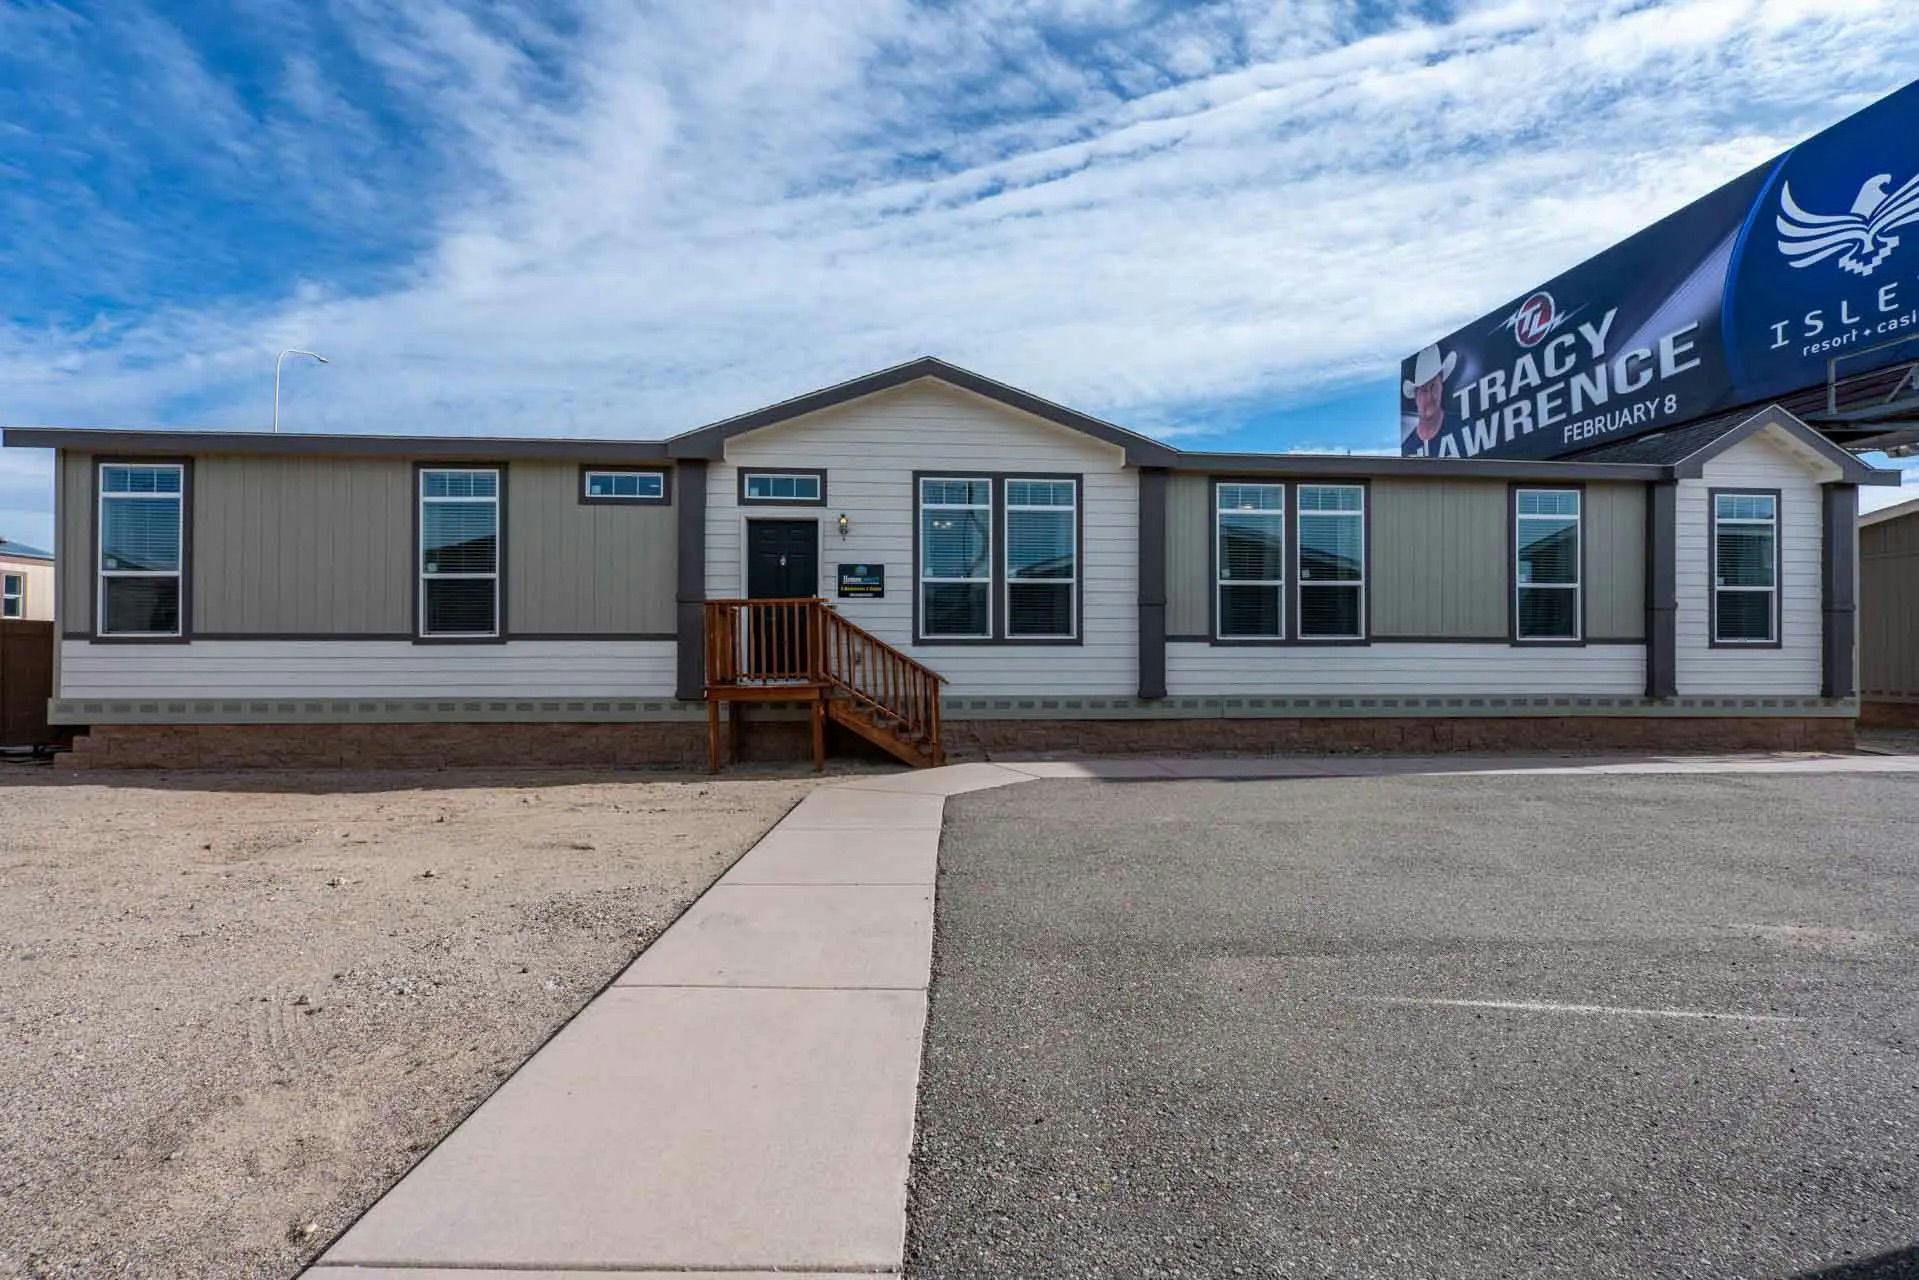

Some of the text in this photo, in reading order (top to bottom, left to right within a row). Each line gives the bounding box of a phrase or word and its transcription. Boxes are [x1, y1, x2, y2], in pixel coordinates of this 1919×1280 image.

[1770, 277, 1919, 349] ISLE
[1803, 328, 1858, 356] resort
[1877, 309, 1919, 333] casi
[1453, 306, 1618, 420] TRACY
[1564, 394, 1677, 444] FEBRUARY 8
